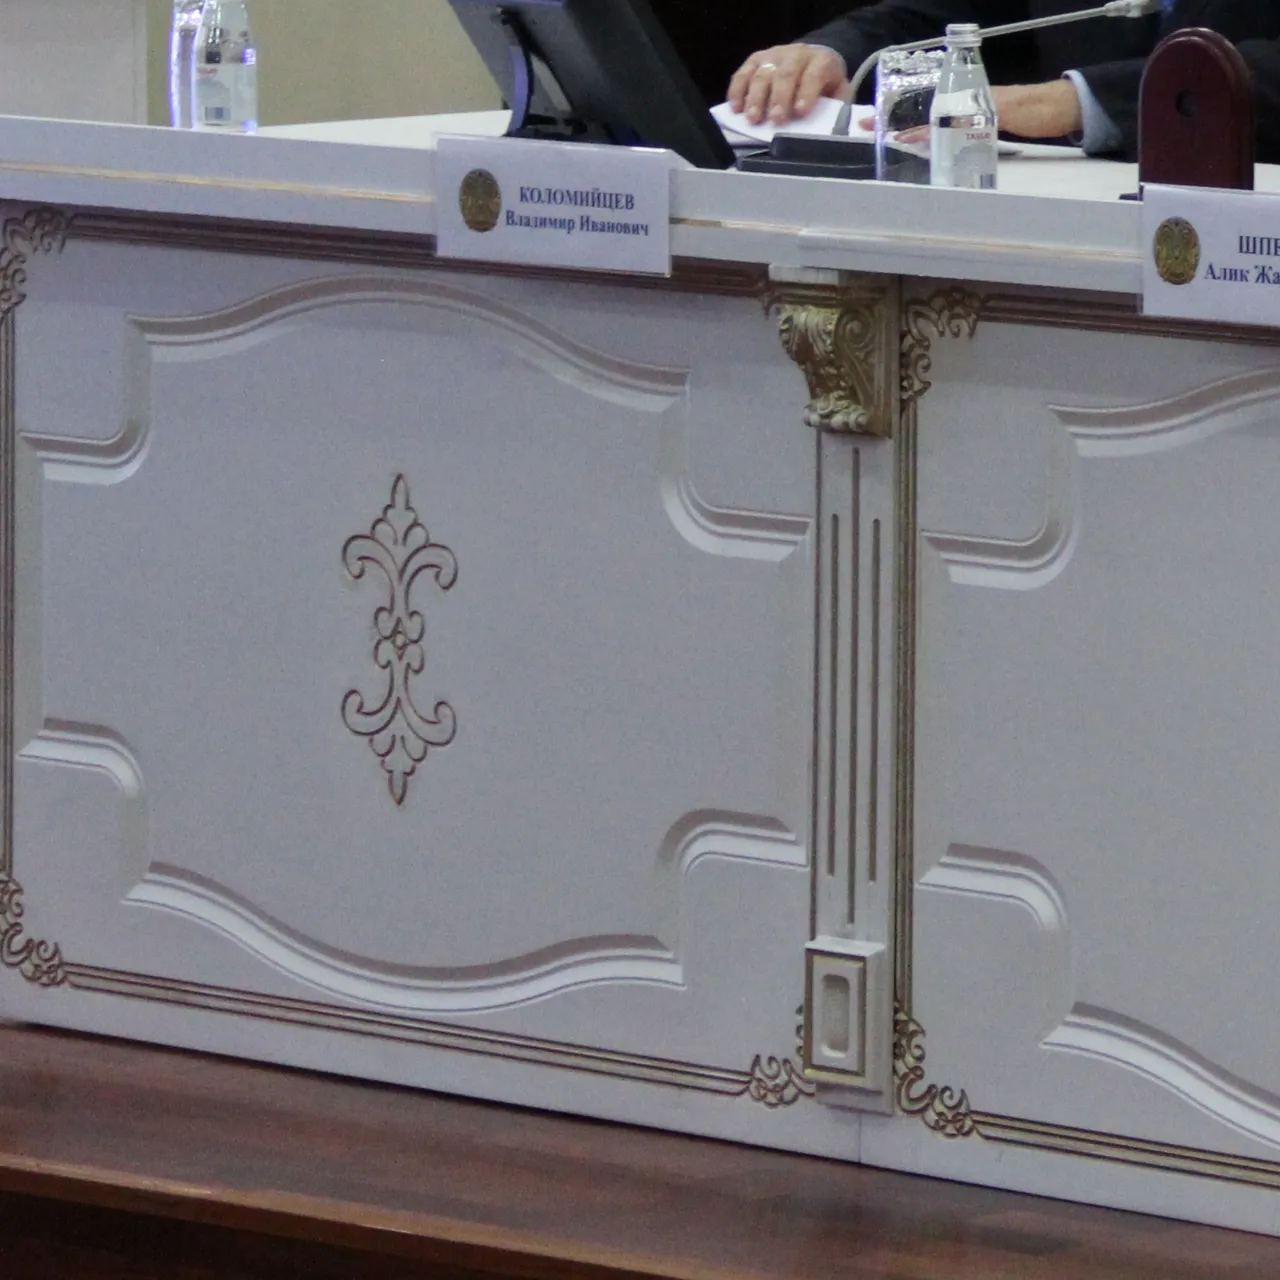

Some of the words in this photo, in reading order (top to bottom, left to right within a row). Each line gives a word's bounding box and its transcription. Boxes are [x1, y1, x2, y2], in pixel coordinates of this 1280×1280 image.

[519, 186, 635, 212] КОЛОМИЙЦЕВ
[505, 210, 576, 234] Владимир
[579, 215, 649, 236] Иванович
[1203, 263, 1250, 282] Алик
